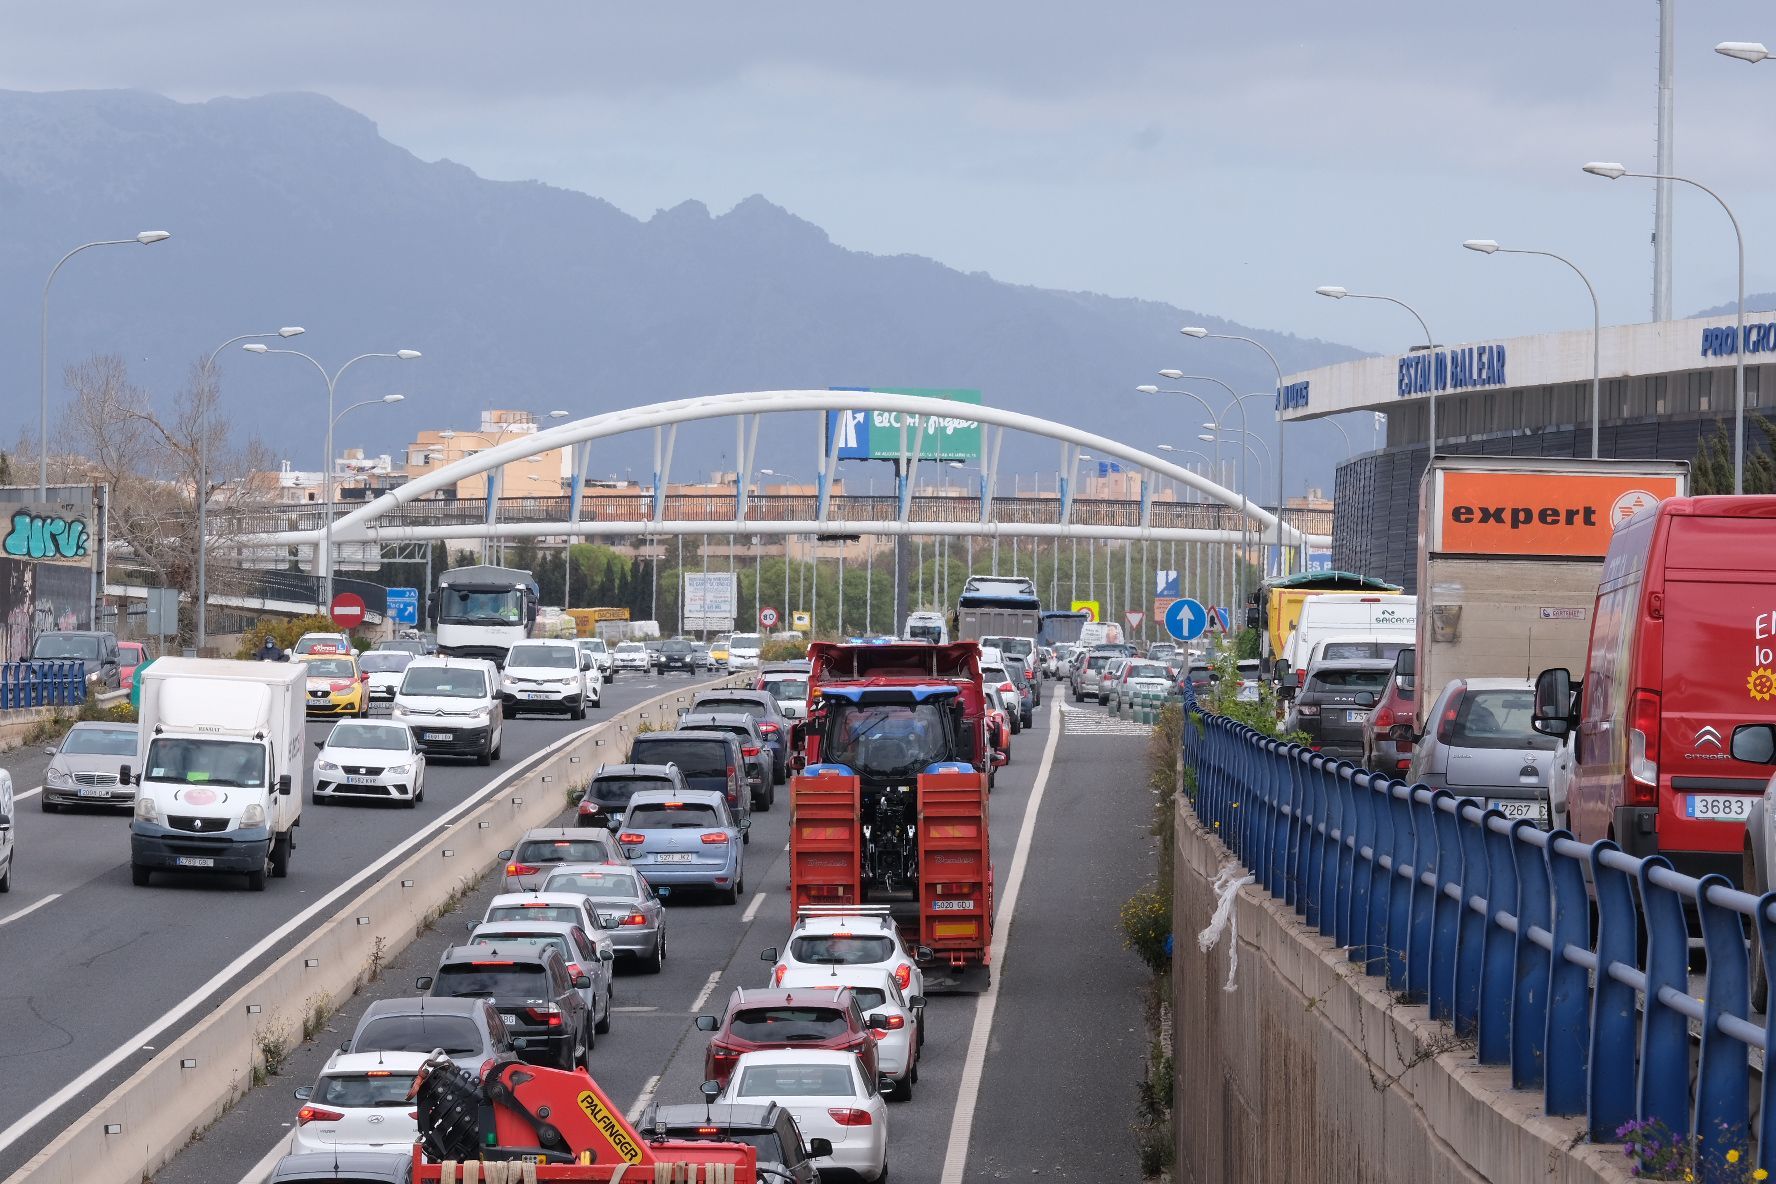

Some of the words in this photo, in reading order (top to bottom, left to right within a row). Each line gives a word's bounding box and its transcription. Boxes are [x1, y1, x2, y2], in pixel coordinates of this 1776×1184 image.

[1450, 344, 1506, 389] BALEAR
[890, 411, 927, 428] Crt
[1451, 505, 1597, 530] expert
[763, 613, 775, 621] 80
[1755, 645, 1773, 667] lo
[1501, 804, 1531, 817] 7267
[1699, 798, 1745, 816] 3683
[502, 1015, 514, 1024] BG
[580, 1093, 639, 1162] PALFINGER
